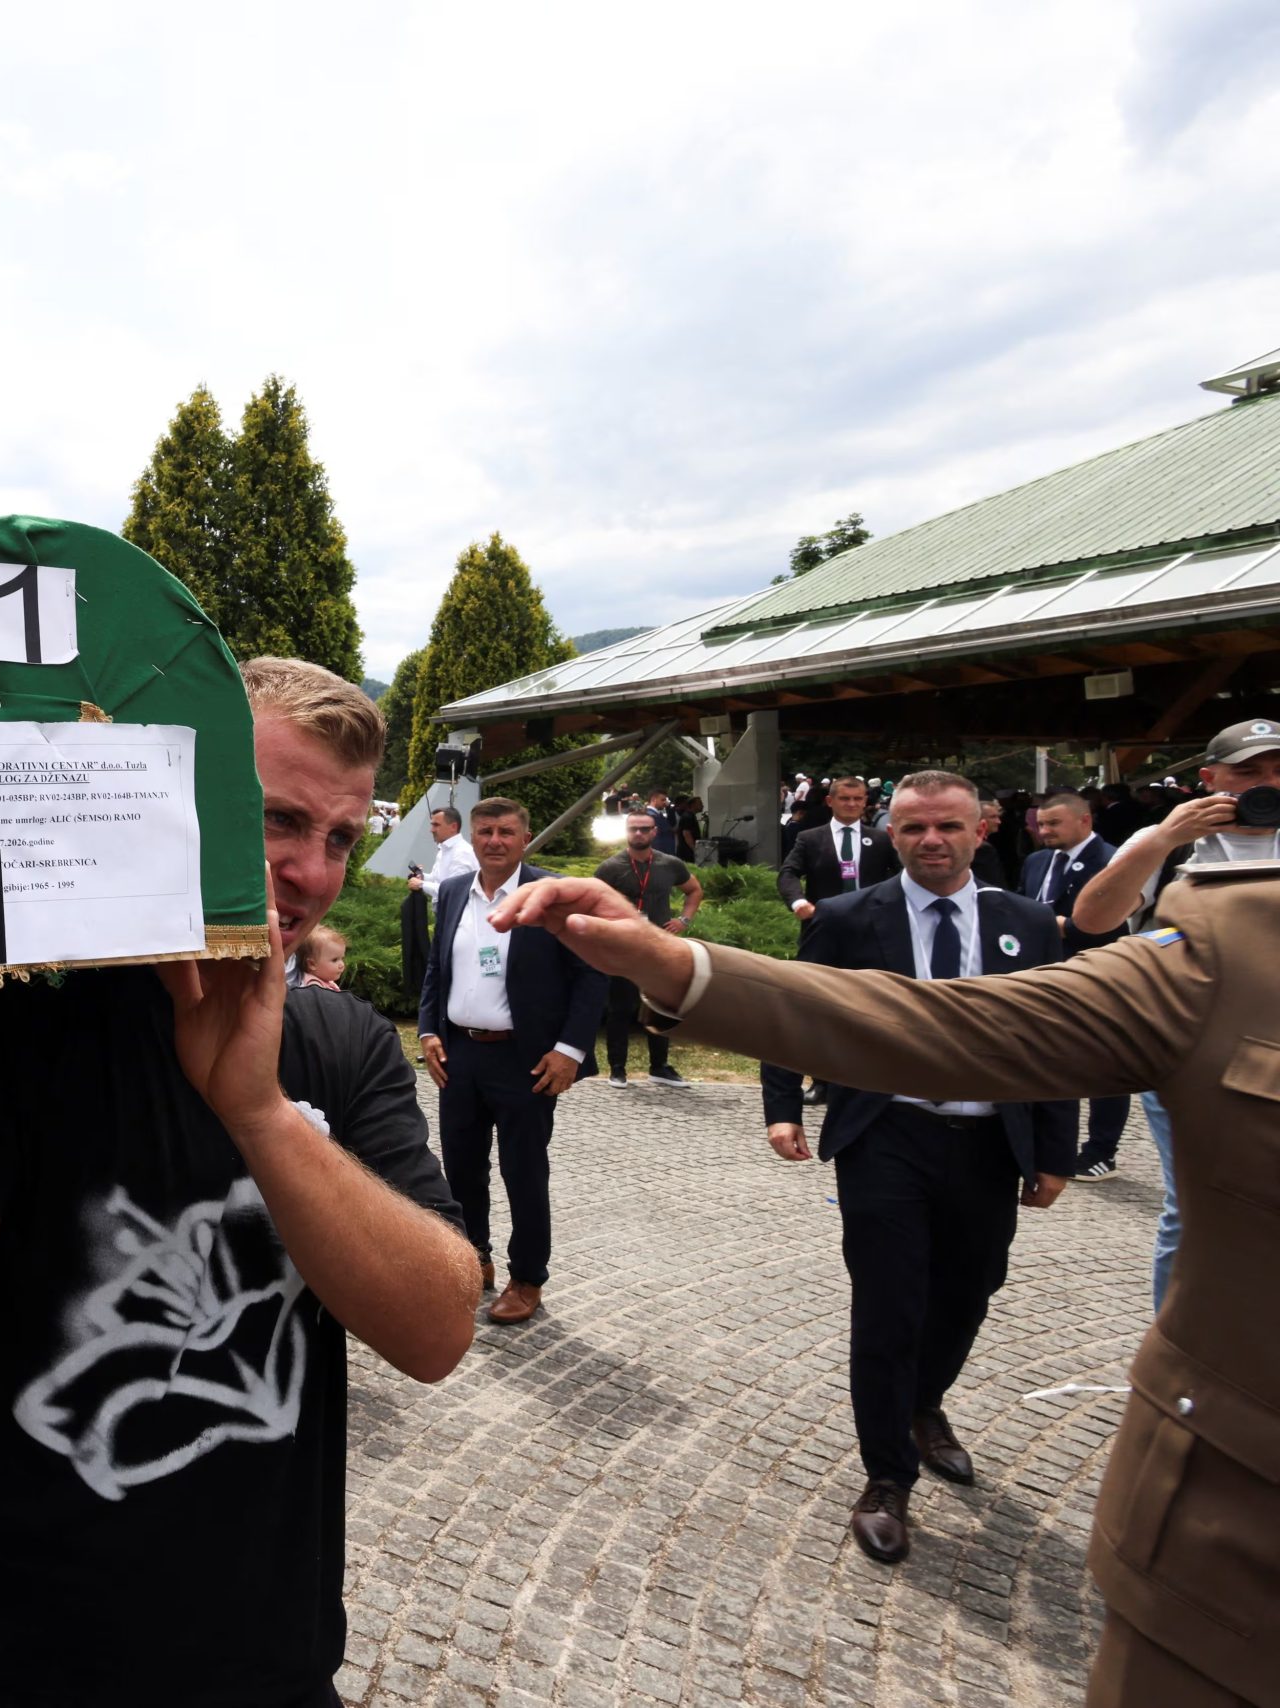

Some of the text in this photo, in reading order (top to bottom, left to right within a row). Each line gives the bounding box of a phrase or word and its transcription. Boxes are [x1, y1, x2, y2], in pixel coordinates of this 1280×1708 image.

[125, 760, 147, 769] Tuzla
[24, 774, 39, 783] ZA
[41, 772, 89, 783] DŽENAZU
[73, 813, 112, 824] (ŠEMSO)
[114, 812, 141, 821] RAMO
[1, 858, 98, 869] OČARI-SREBRENICA
[57, 880, 75, 889] 1995
